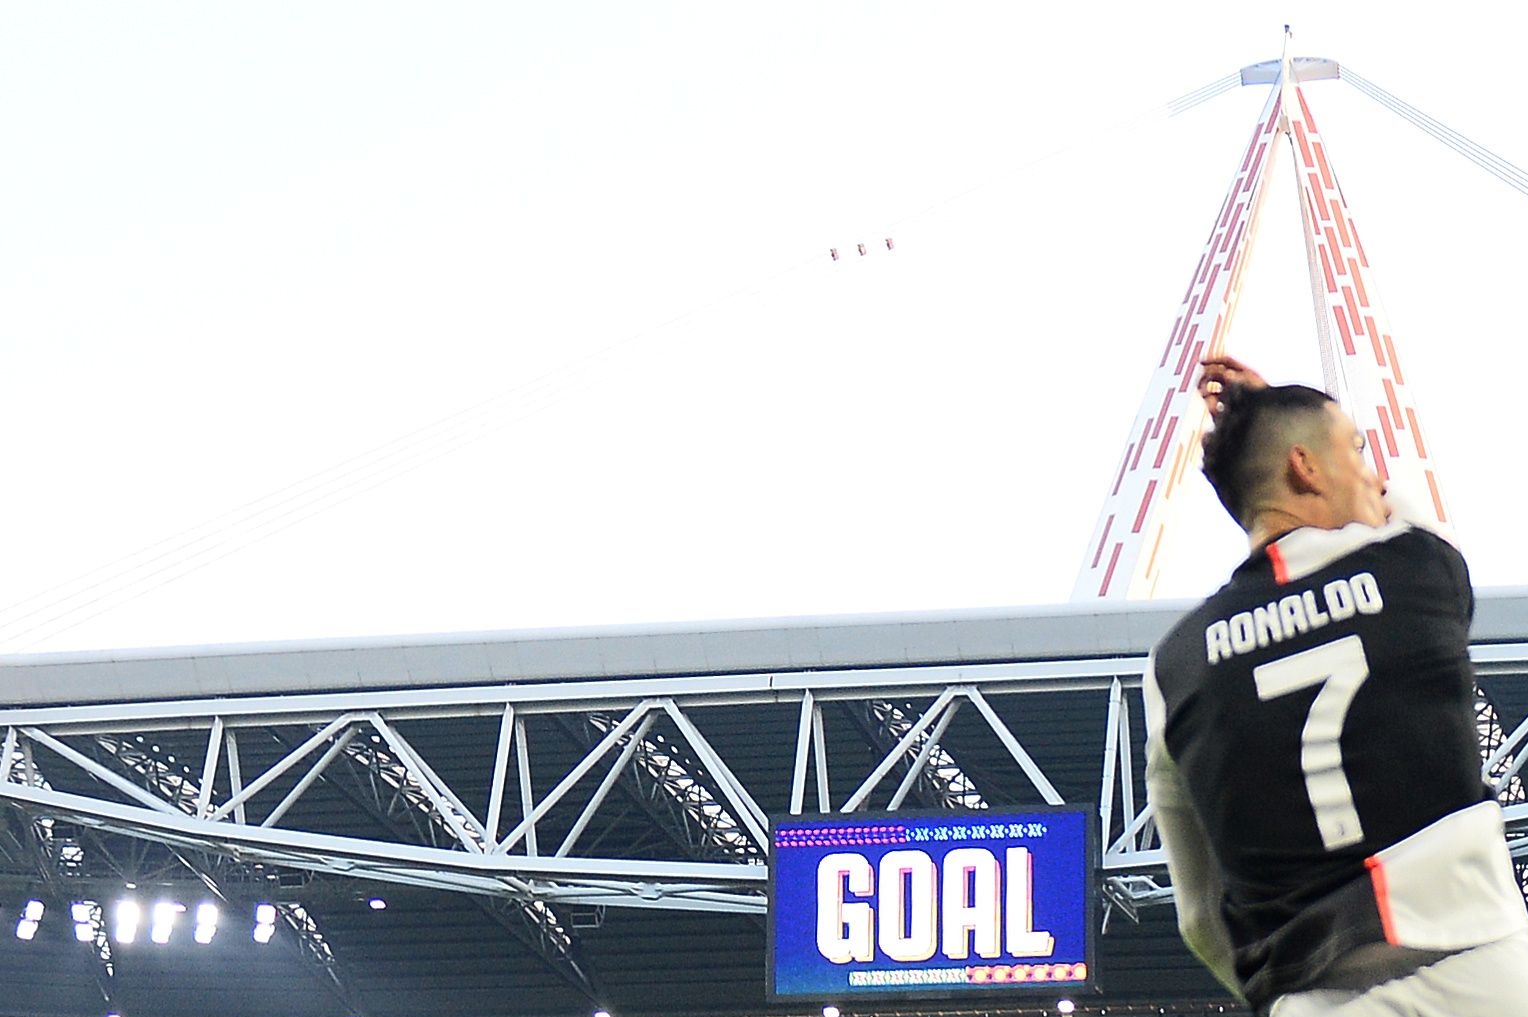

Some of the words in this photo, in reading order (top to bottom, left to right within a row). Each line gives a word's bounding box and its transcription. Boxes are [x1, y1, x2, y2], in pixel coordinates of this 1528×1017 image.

[1205, 572, 1383, 666] RONALDO
[1254, 634, 1370, 851] 7
[815, 846, 1054, 964] GOAL
